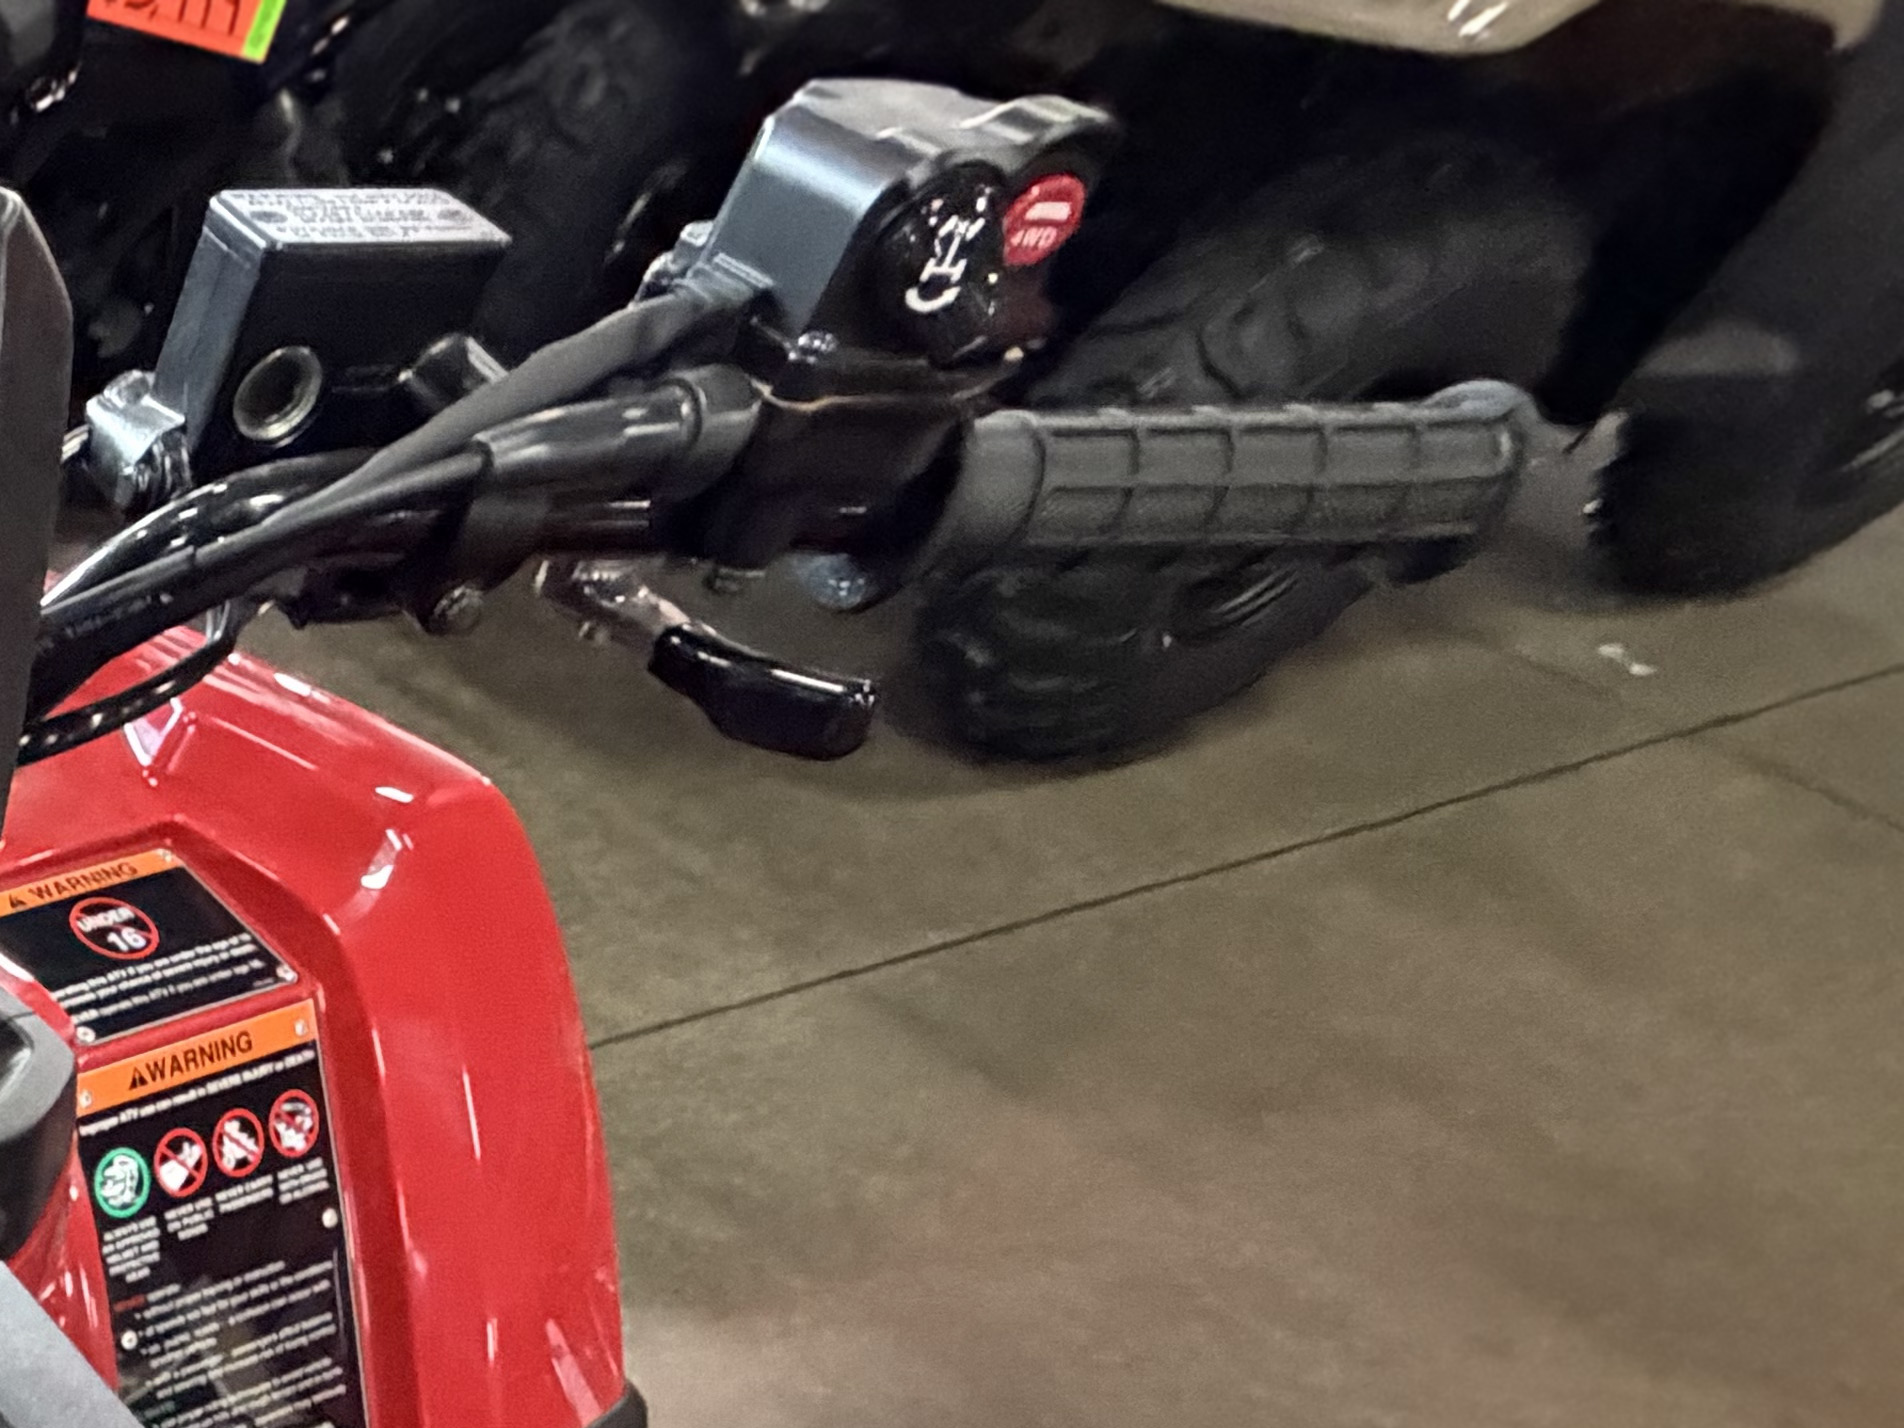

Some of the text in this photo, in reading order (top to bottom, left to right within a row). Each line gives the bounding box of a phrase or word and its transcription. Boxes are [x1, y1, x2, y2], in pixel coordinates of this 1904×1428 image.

[28, 861, 138, 900] WARNING
[106, 927, 148, 952] 16
[146, 1031, 254, 1082] WARNING
